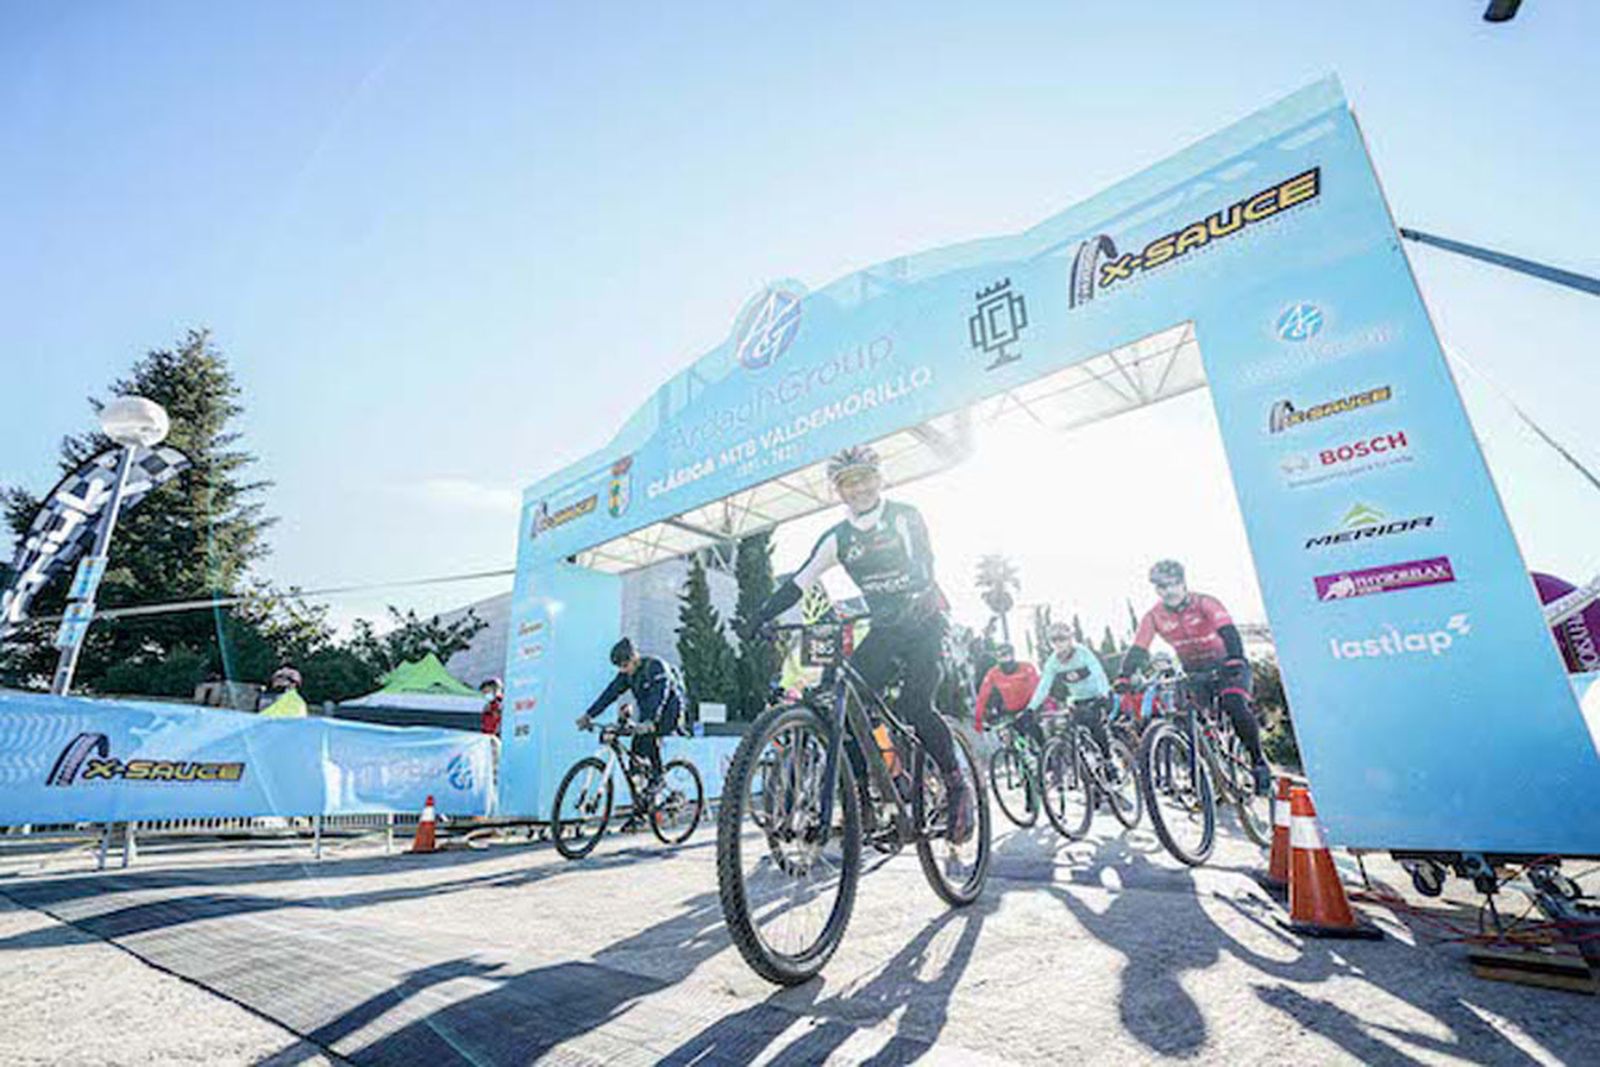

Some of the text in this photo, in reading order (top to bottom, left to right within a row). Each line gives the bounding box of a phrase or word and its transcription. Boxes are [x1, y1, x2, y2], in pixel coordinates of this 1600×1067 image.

[1099, 167, 1320, 288] X-SAUCE
[759, 366, 931, 451] VALDEMORILLO
[1319, 430, 1408, 466] BOSCH
[1305, 516, 1434, 549] MERIDA
[1330, 629, 1452, 659] lastlap
[82, 757, 246, 781] X-SAUCE
